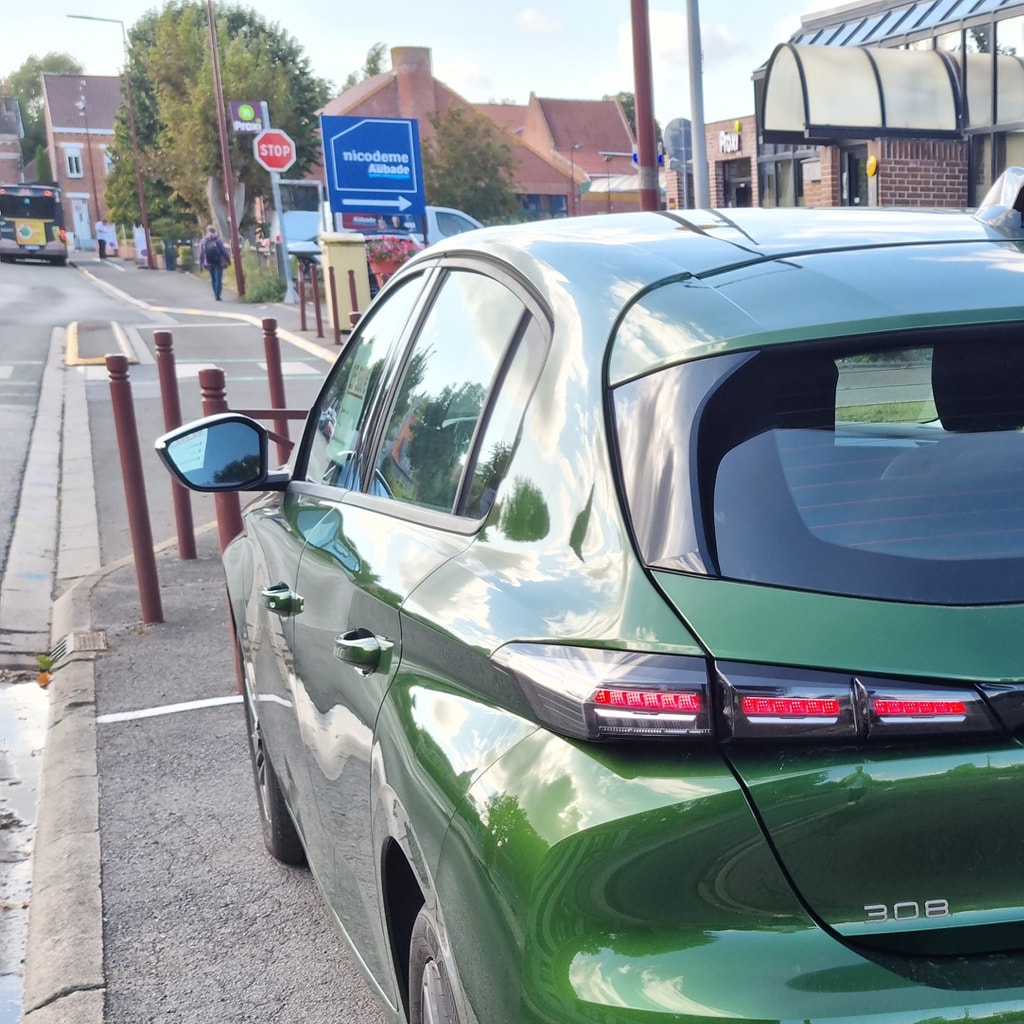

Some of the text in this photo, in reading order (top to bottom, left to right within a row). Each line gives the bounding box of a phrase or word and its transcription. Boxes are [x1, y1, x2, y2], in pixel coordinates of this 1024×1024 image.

[259, 144, 291, 157] STOP
[342, 149, 409, 163] nicodeme
[864, 899, 949, 924] 308
